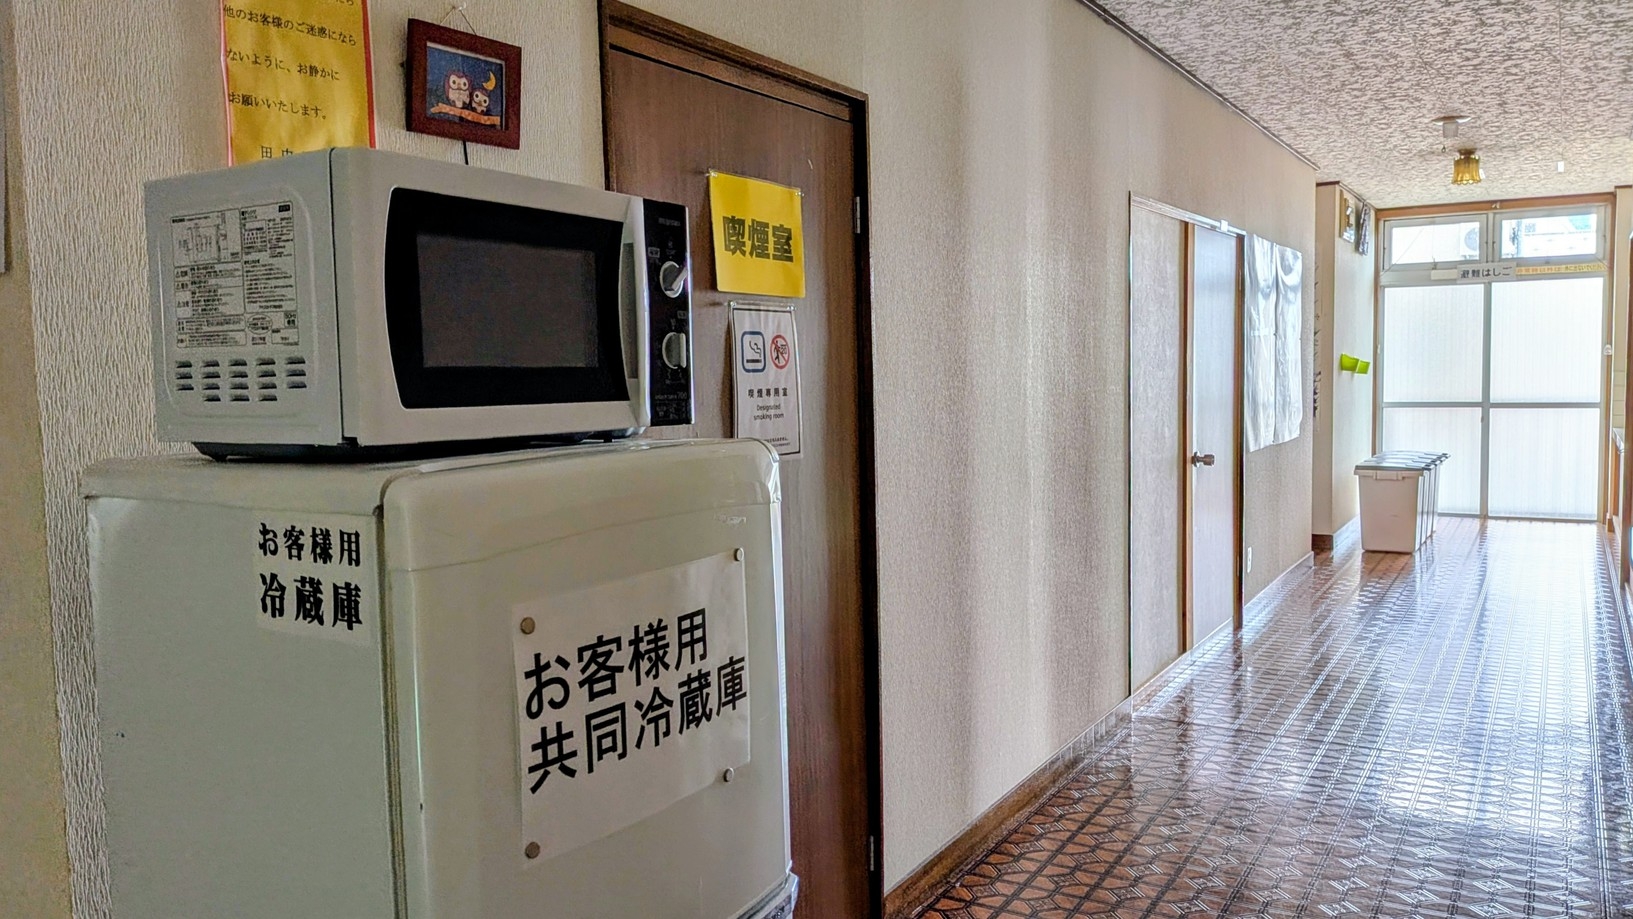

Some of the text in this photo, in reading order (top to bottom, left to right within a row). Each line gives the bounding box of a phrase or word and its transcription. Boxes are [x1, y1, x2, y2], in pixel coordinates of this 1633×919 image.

[223, 5, 357, 46] 他のお客様のご迷惑になら
[226, 48, 340, 81] ないように、お静かに
[228, 92, 327, 120] お願いいたします。
[722, 215, 794, 264] 喫煙室
[1460, 266, 1513, 279] 避難はしご
[747, 387, 788, 399] 喫煙専用室
[756, 403, 781, 412] Designated
[258, 523, 361, 567] お客様用
[259, 573, 363, 630] 冷蔵庫
[523, 608, 708, 720] お客様用
[528, 656, 747, 794] 共同冷蔵庫
